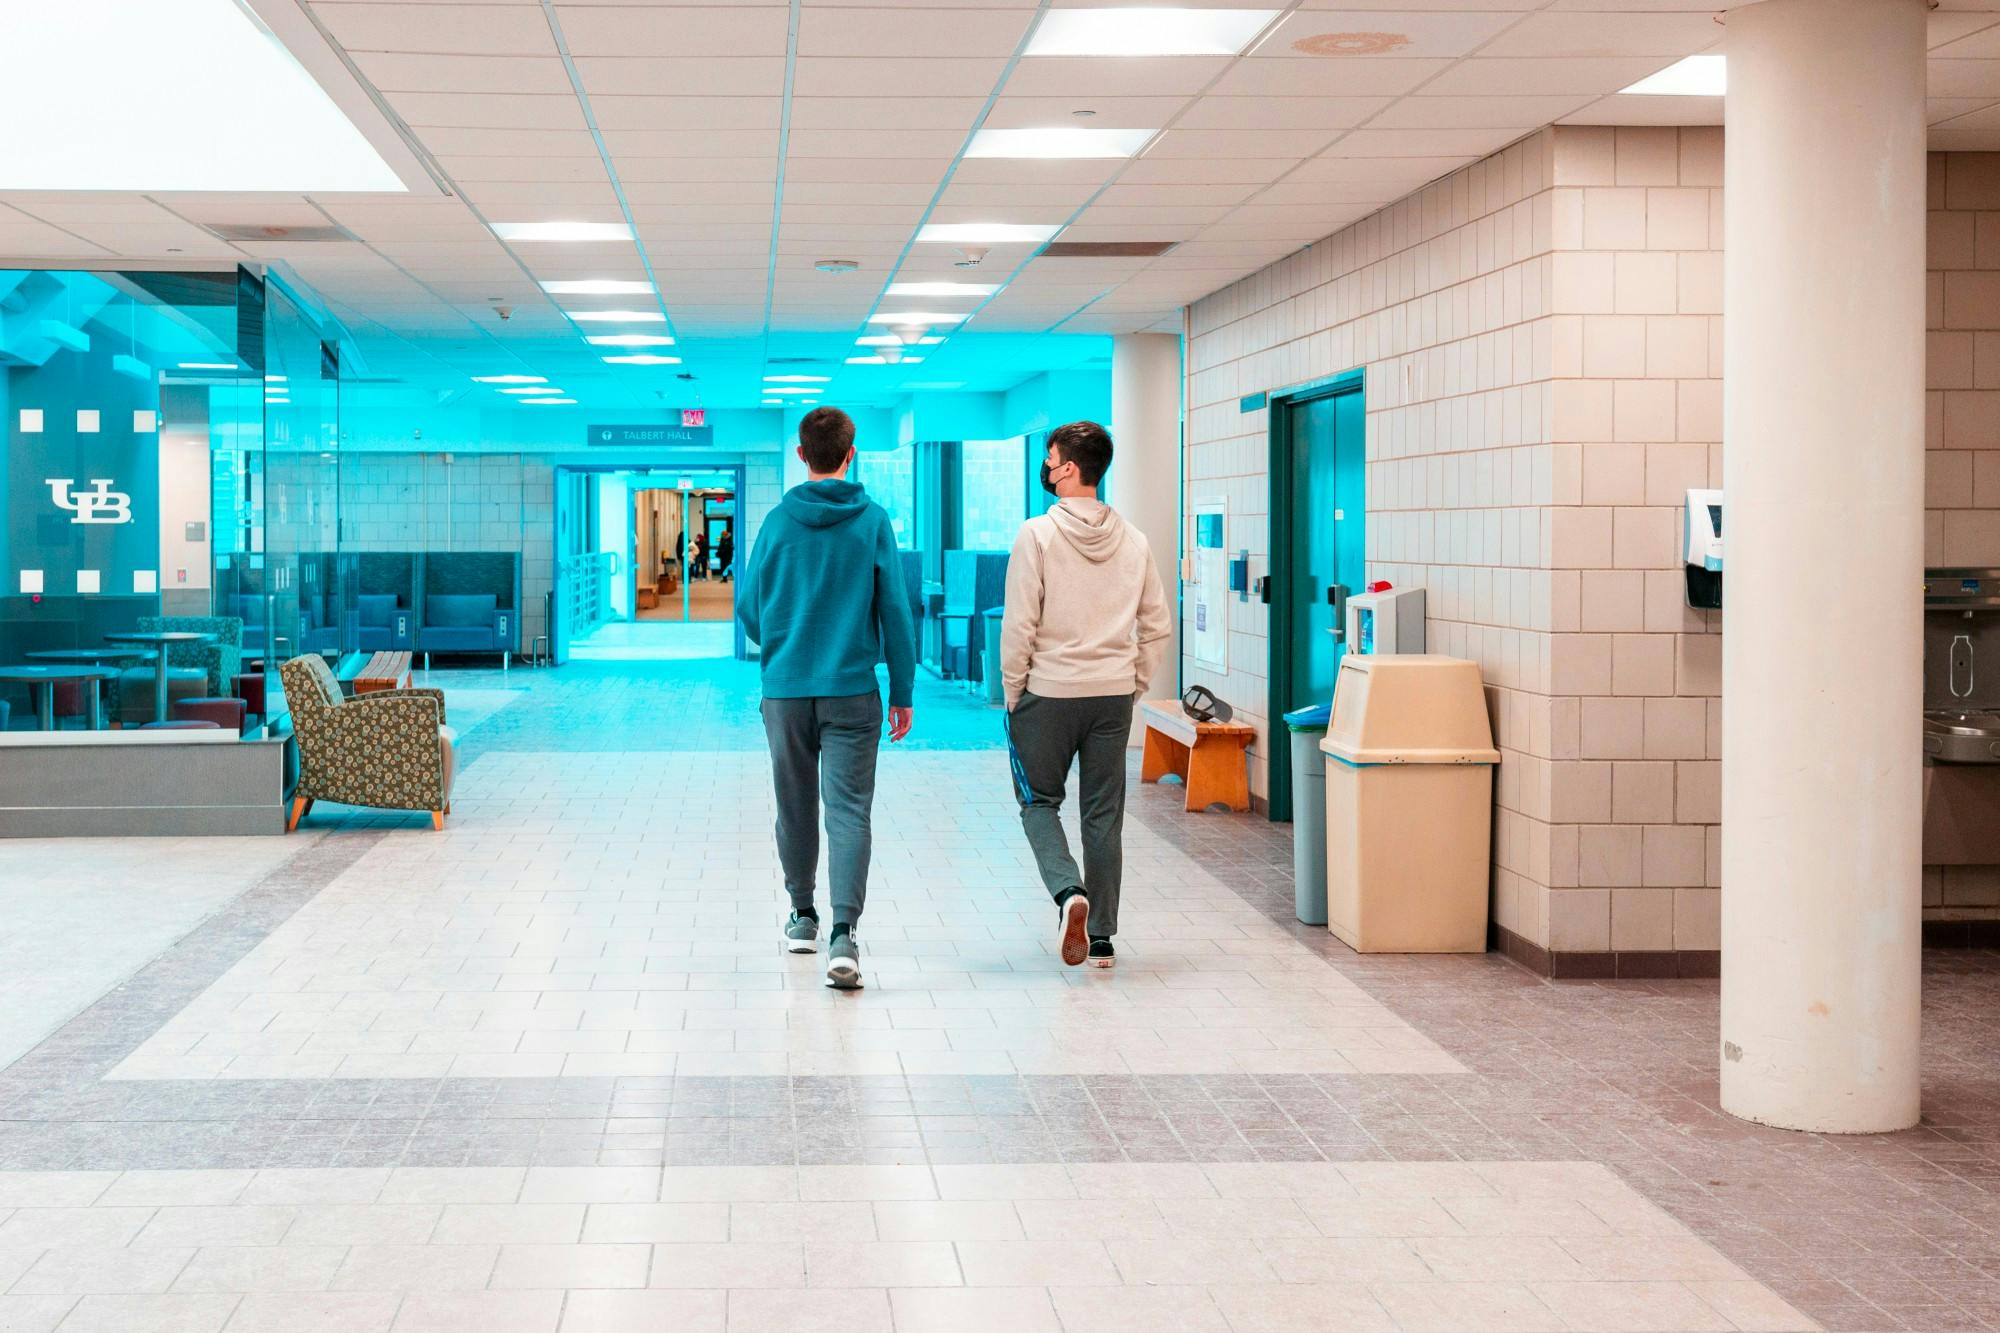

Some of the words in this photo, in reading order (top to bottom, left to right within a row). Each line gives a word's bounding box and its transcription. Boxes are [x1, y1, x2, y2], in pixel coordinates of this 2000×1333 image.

[624, 431, 665, 440] TALBERT
[667, 431, 693, 440] HALL
[45, 478, 132, 524] UB
